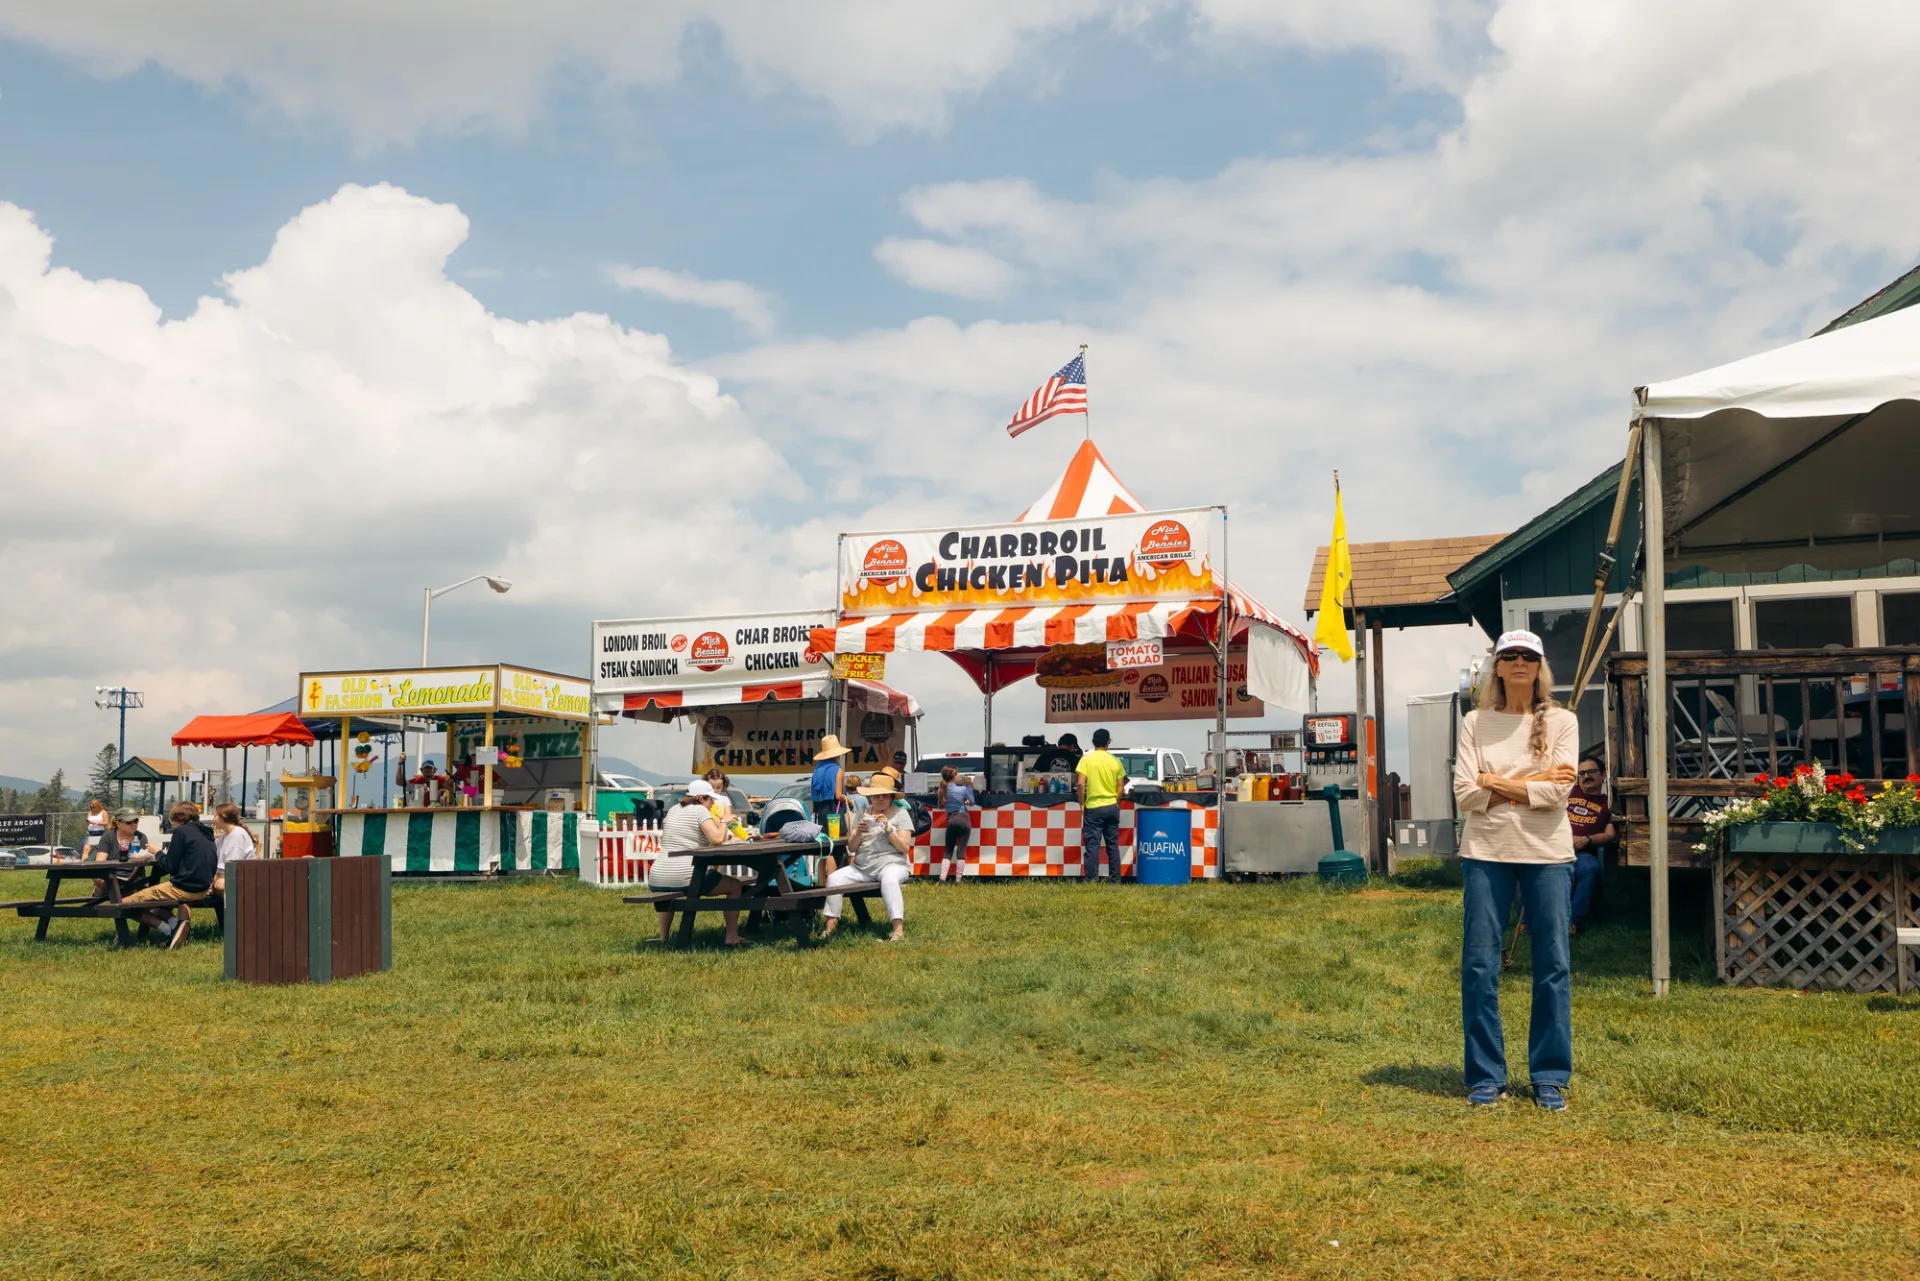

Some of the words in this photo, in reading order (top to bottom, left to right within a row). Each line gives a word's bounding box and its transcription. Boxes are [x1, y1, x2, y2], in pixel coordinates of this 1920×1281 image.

[1151, 524, 1180, 536] Nick
[874, 544, 899, 554] Nick
[939, 527, 1106, 560] CHARBROIL
[1142, 540, 1187, 552] Bennies
[915, 562, 1043, 592] CHICKEN
[1055, 555, 1128, 586] PITA
[603, 634, 639, 652] LONDON
[641, 633, 668, 651] BROIL
[701, 635, 720, 646] Nick
[735, 627, 769, 645] CHAR
[695, 647, 726, 657] Bennies
[805, 653, 819, 663] PITA
[841, 654, 880, 664] BUCKET
[1109, 644, 1160, 657] TOMATO
[600, 660, 629, 678] STEAK
[631, 658, 678, 676] SANDWICH
[745, 652, 799, 671] CHICKEN
[1121, 655, 1160, 666] SALAD
[514, 674, 532, 690] OLD
[844, 670, 875, 679] FRIES
[1171, 666, 1210, 684] ITALIAN
[342, 678, 367, 693] OLD
[392, 673, 493, 708] Lemonade
[325, 693, 383, 710] FASHION
[501, 687, 543, 708] FASHION
[547, 684, 592, 713] Lemon
[1051, 693, 1078, 712] STEAK
[1080, 691, 1131, 710] SANDWICH
[1181, 688, 1233, 708] SANDWH
[747, 727, 826, 742] CHARBRO
[714, 746, 815, 767] CHICKEN
[633, 835, 661, 853] ITAL
[1138, 841, 1186, 856] AQUAFINA
